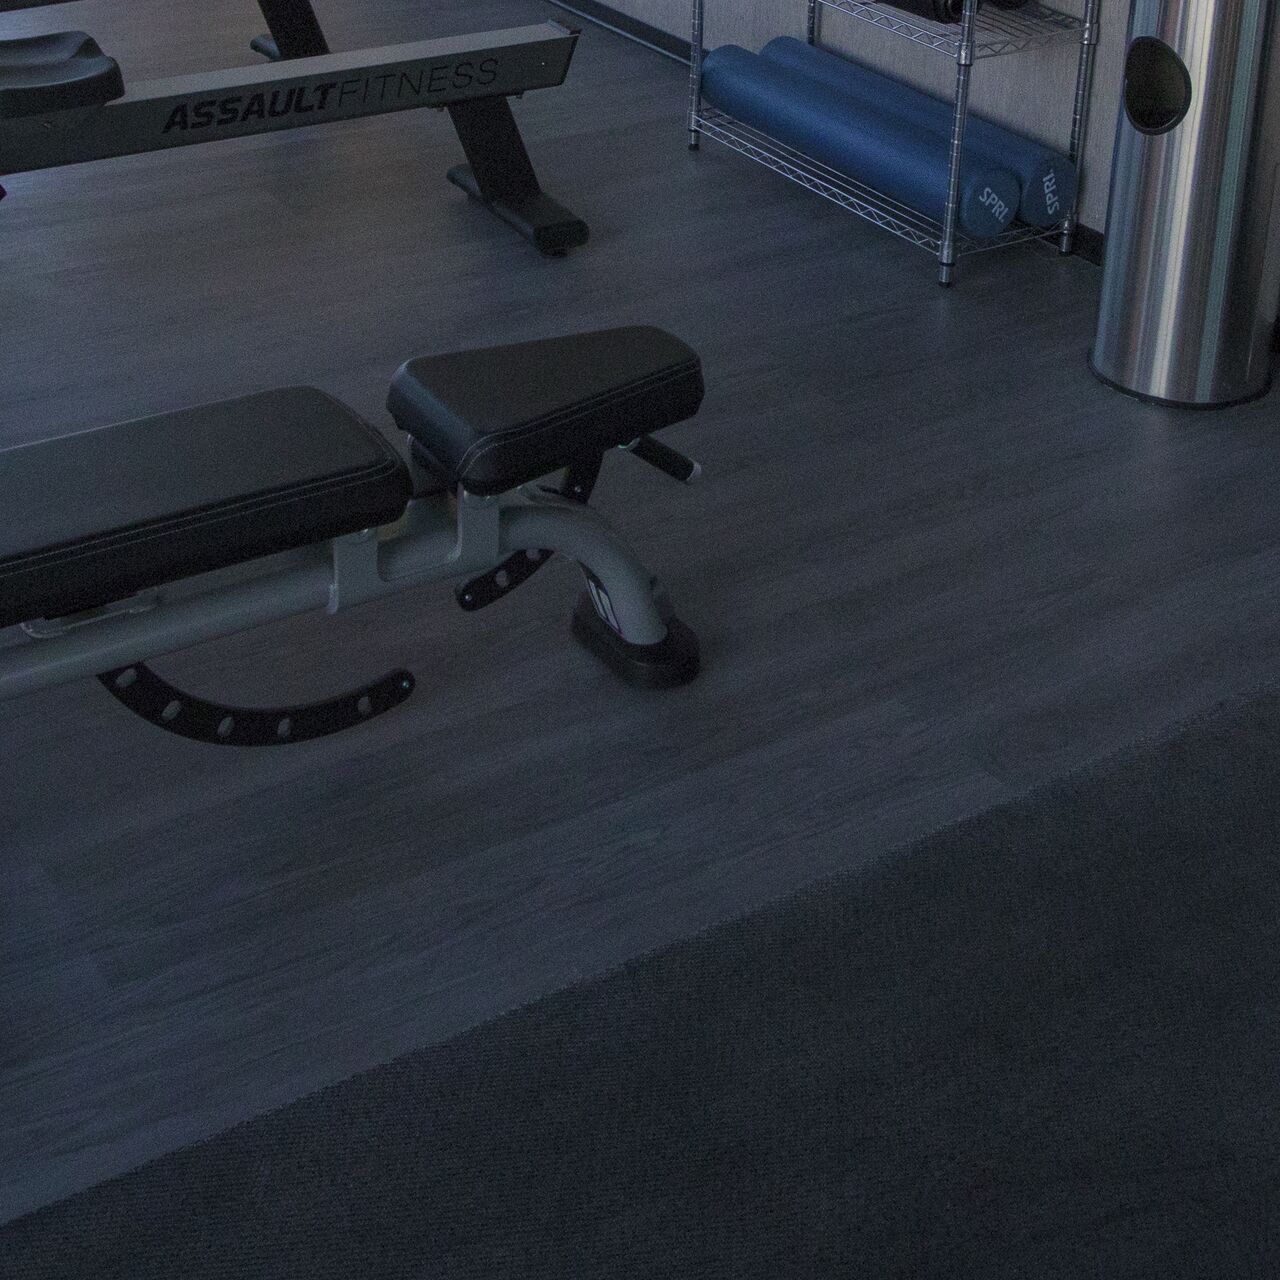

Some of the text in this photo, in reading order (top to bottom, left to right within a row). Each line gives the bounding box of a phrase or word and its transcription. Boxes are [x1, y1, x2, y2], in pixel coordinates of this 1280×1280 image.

[162, 57, 503, 135] ASSAULTFITNESS
[978, 186, 1009, 222] SPRI
[1042, 171, 1060, 215] SPRI
